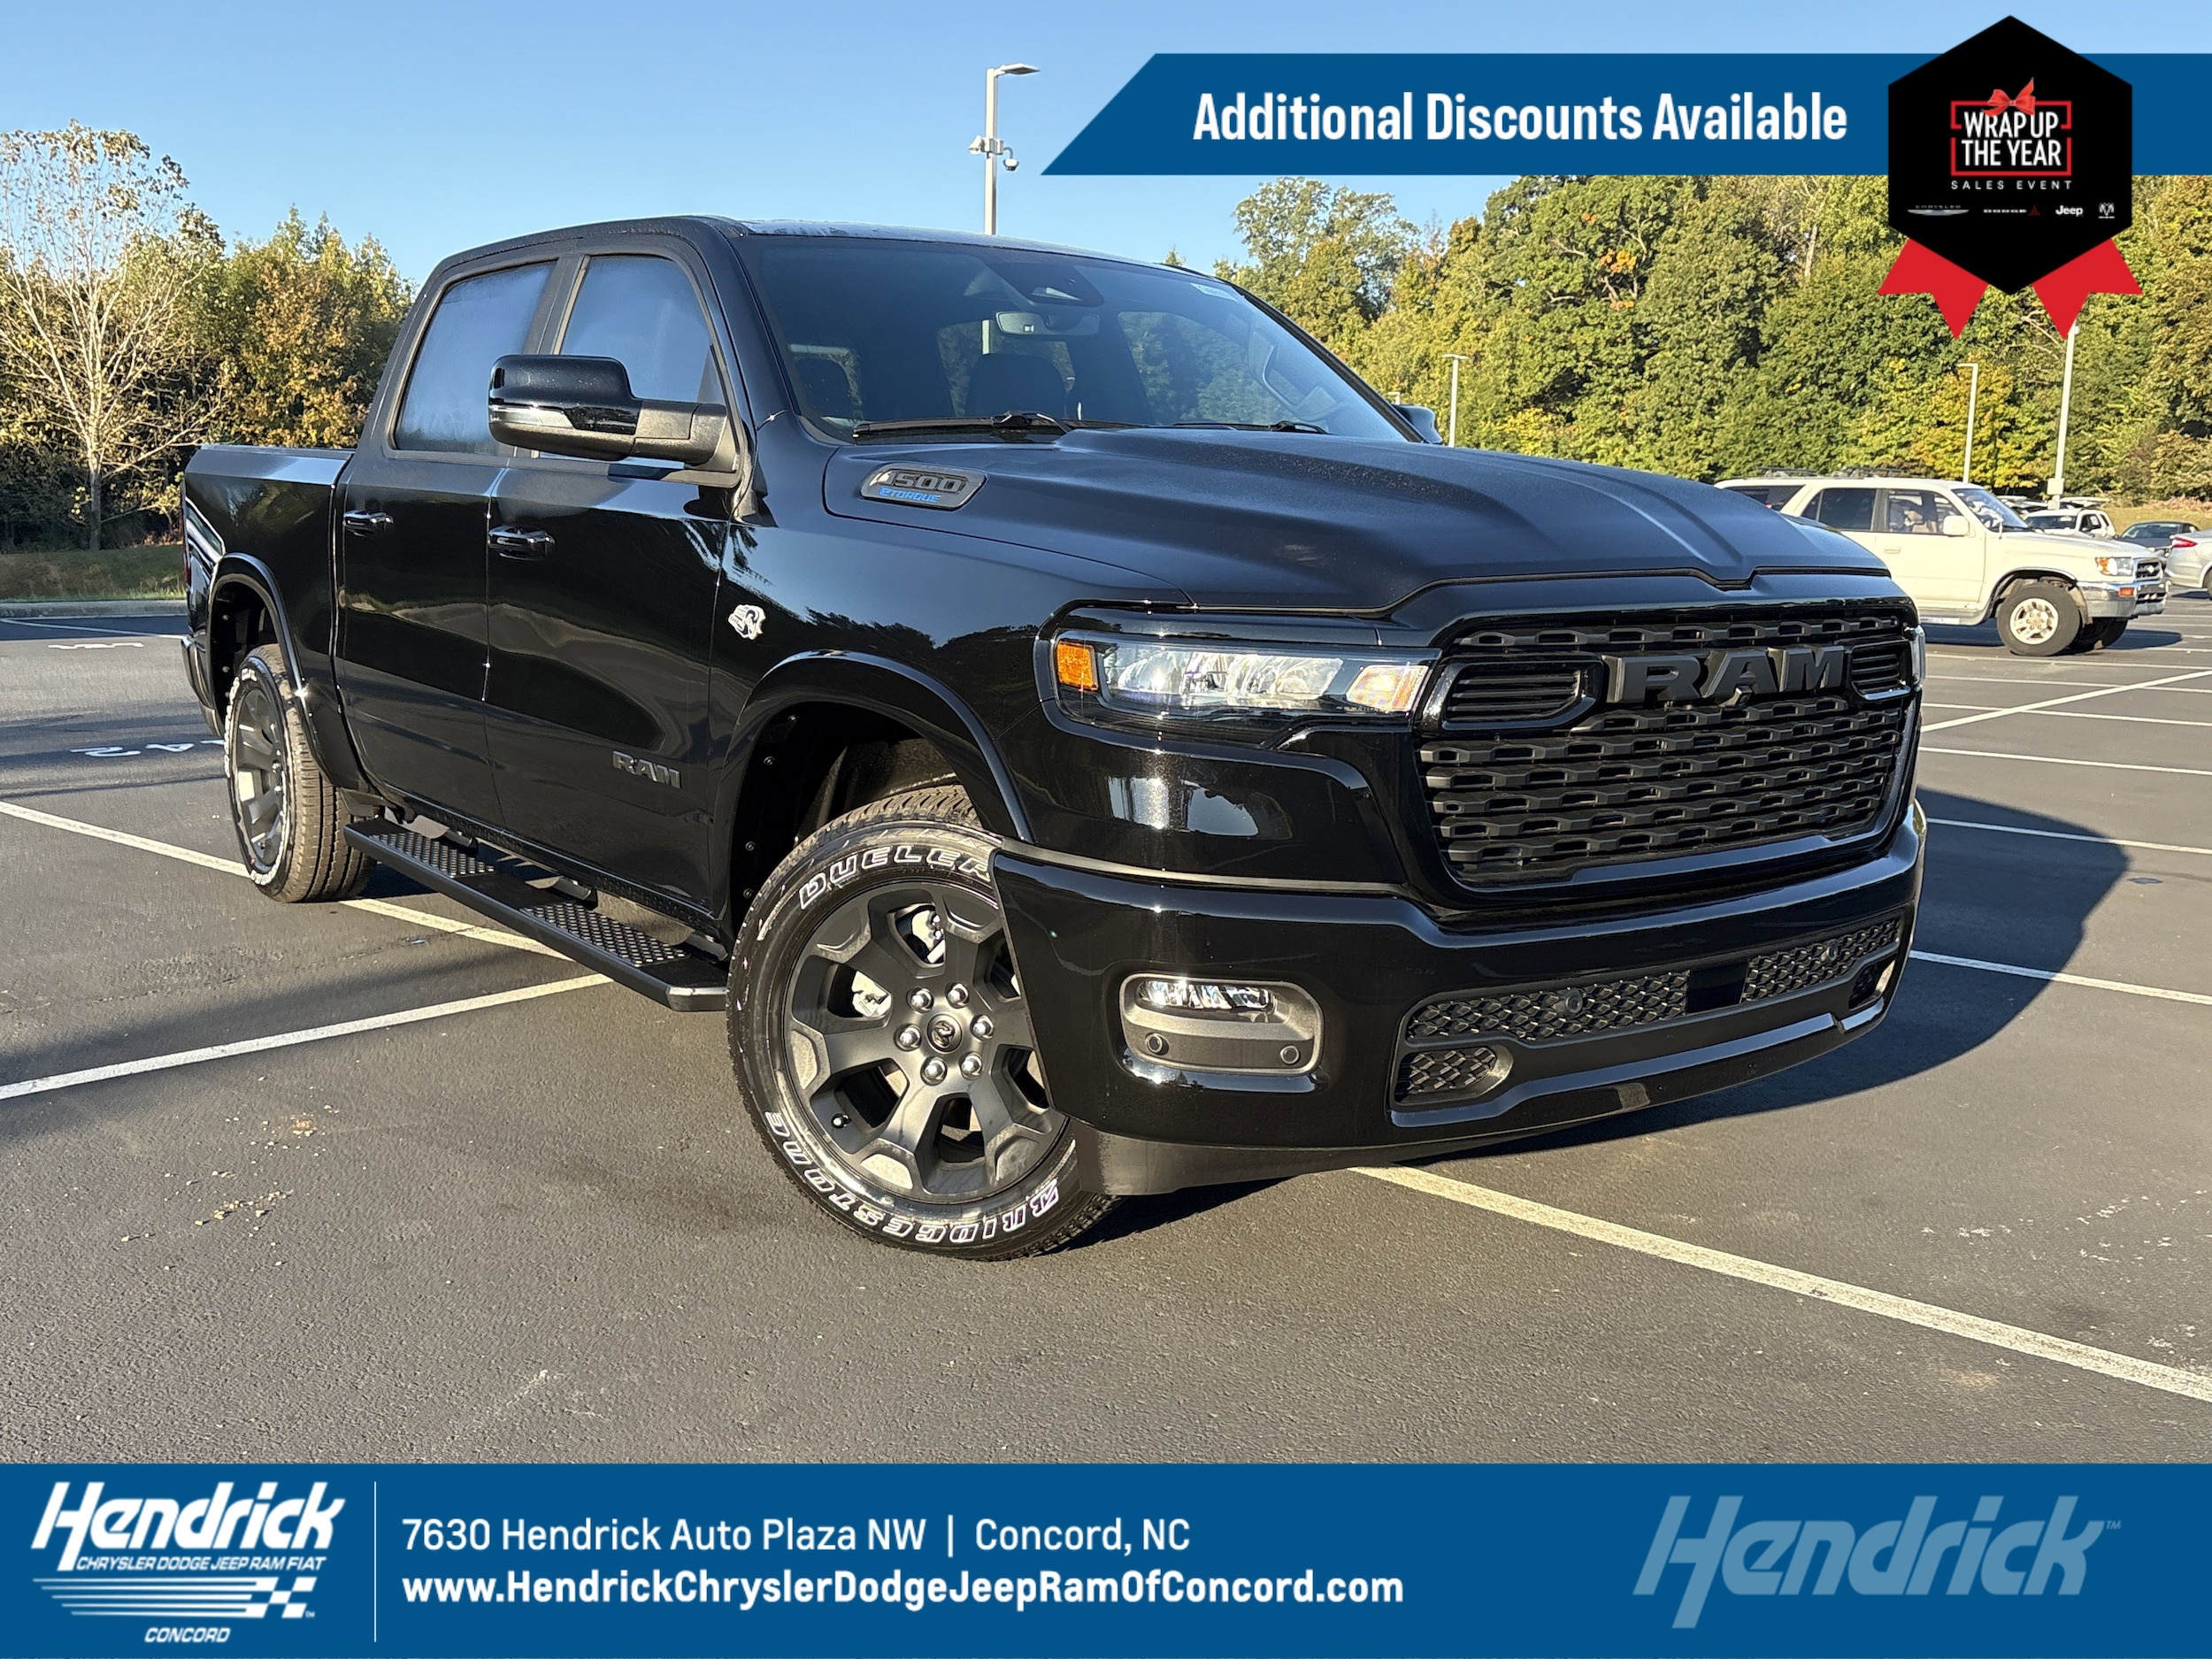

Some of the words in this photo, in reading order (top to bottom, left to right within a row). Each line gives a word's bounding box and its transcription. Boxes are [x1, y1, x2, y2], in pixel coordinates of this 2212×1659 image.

[883, 470, 965, 494] 1500
[1601, 646, 1846, 703] RAM
[612, 750, 681, 789] RAM
[798, 844, 991, 910] DUELER
[764, 1111, 1059, 1244] BRIDGESTONE
